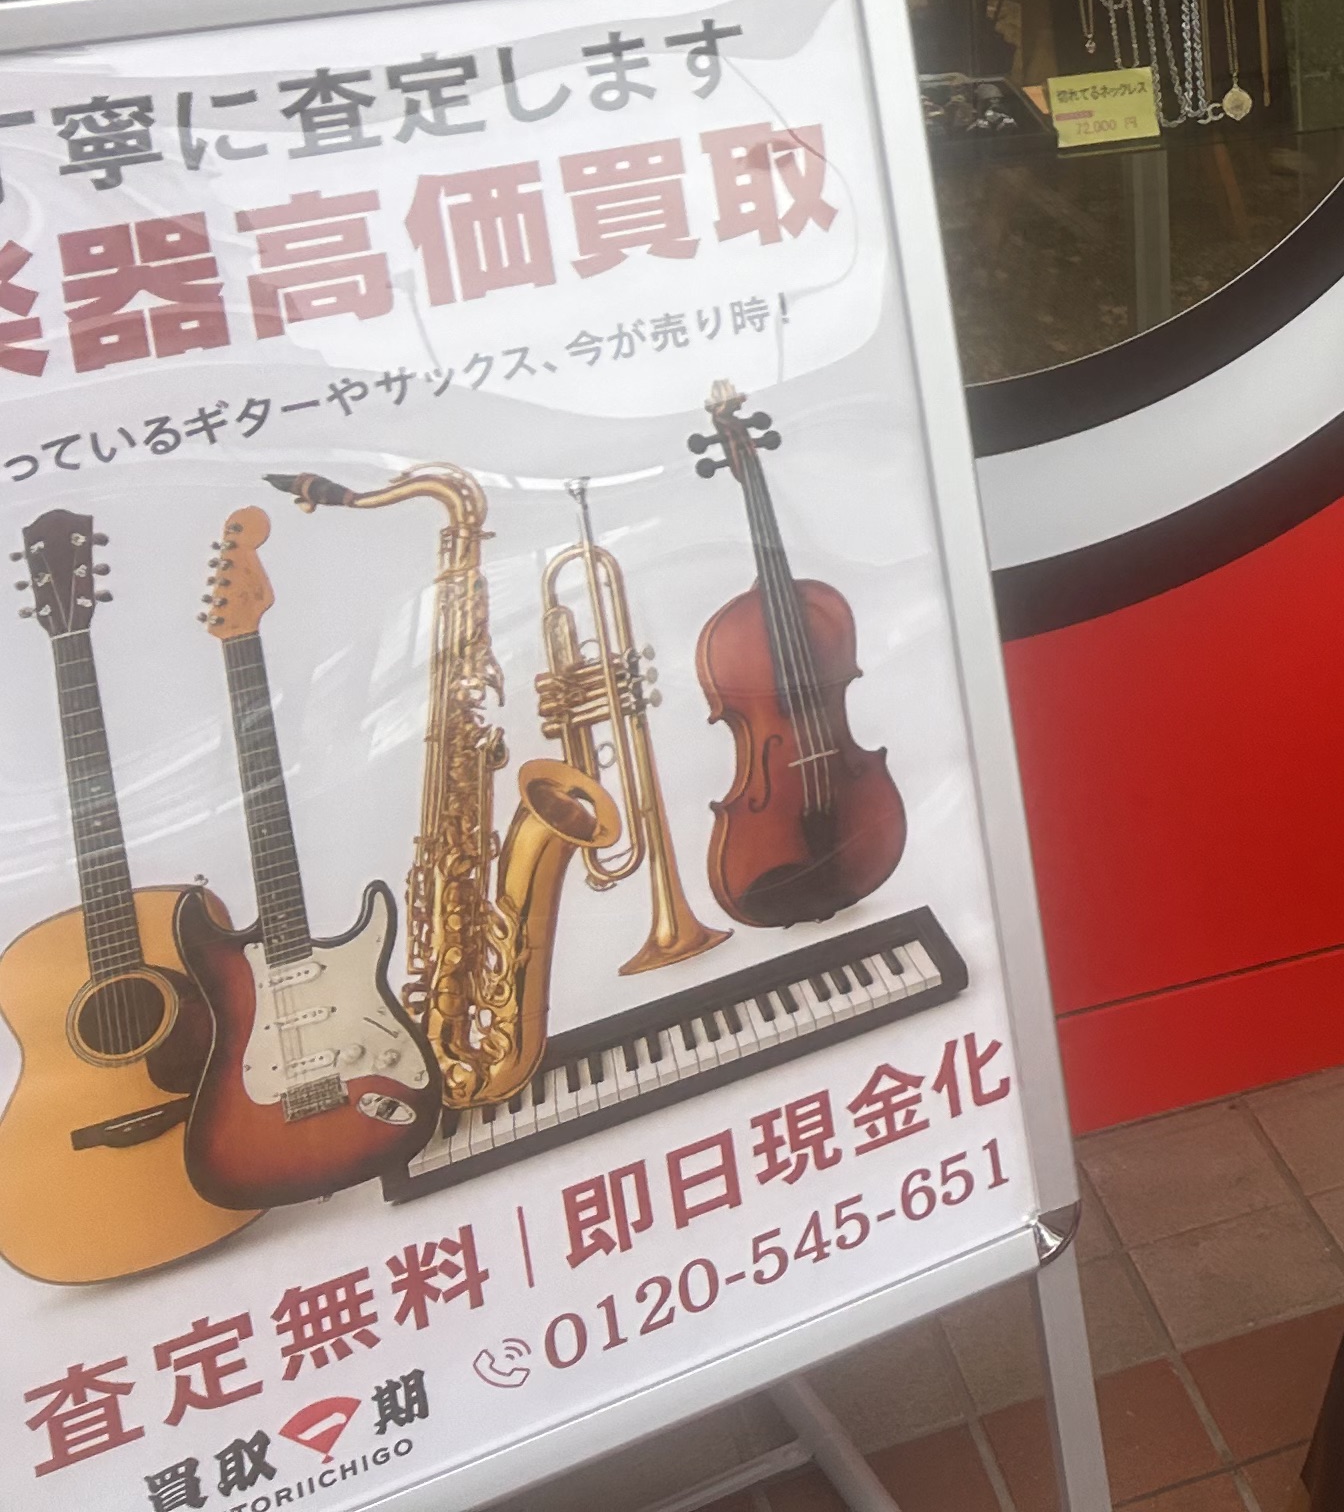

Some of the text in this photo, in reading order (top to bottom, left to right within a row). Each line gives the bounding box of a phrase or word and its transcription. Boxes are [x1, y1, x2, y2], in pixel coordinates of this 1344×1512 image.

[544, 1138, 1011, 1370] 0120-545-651
[561, 1032, 1012, 1270] 即日現金化
[23, 1223, 490, 1478] 査定無料
